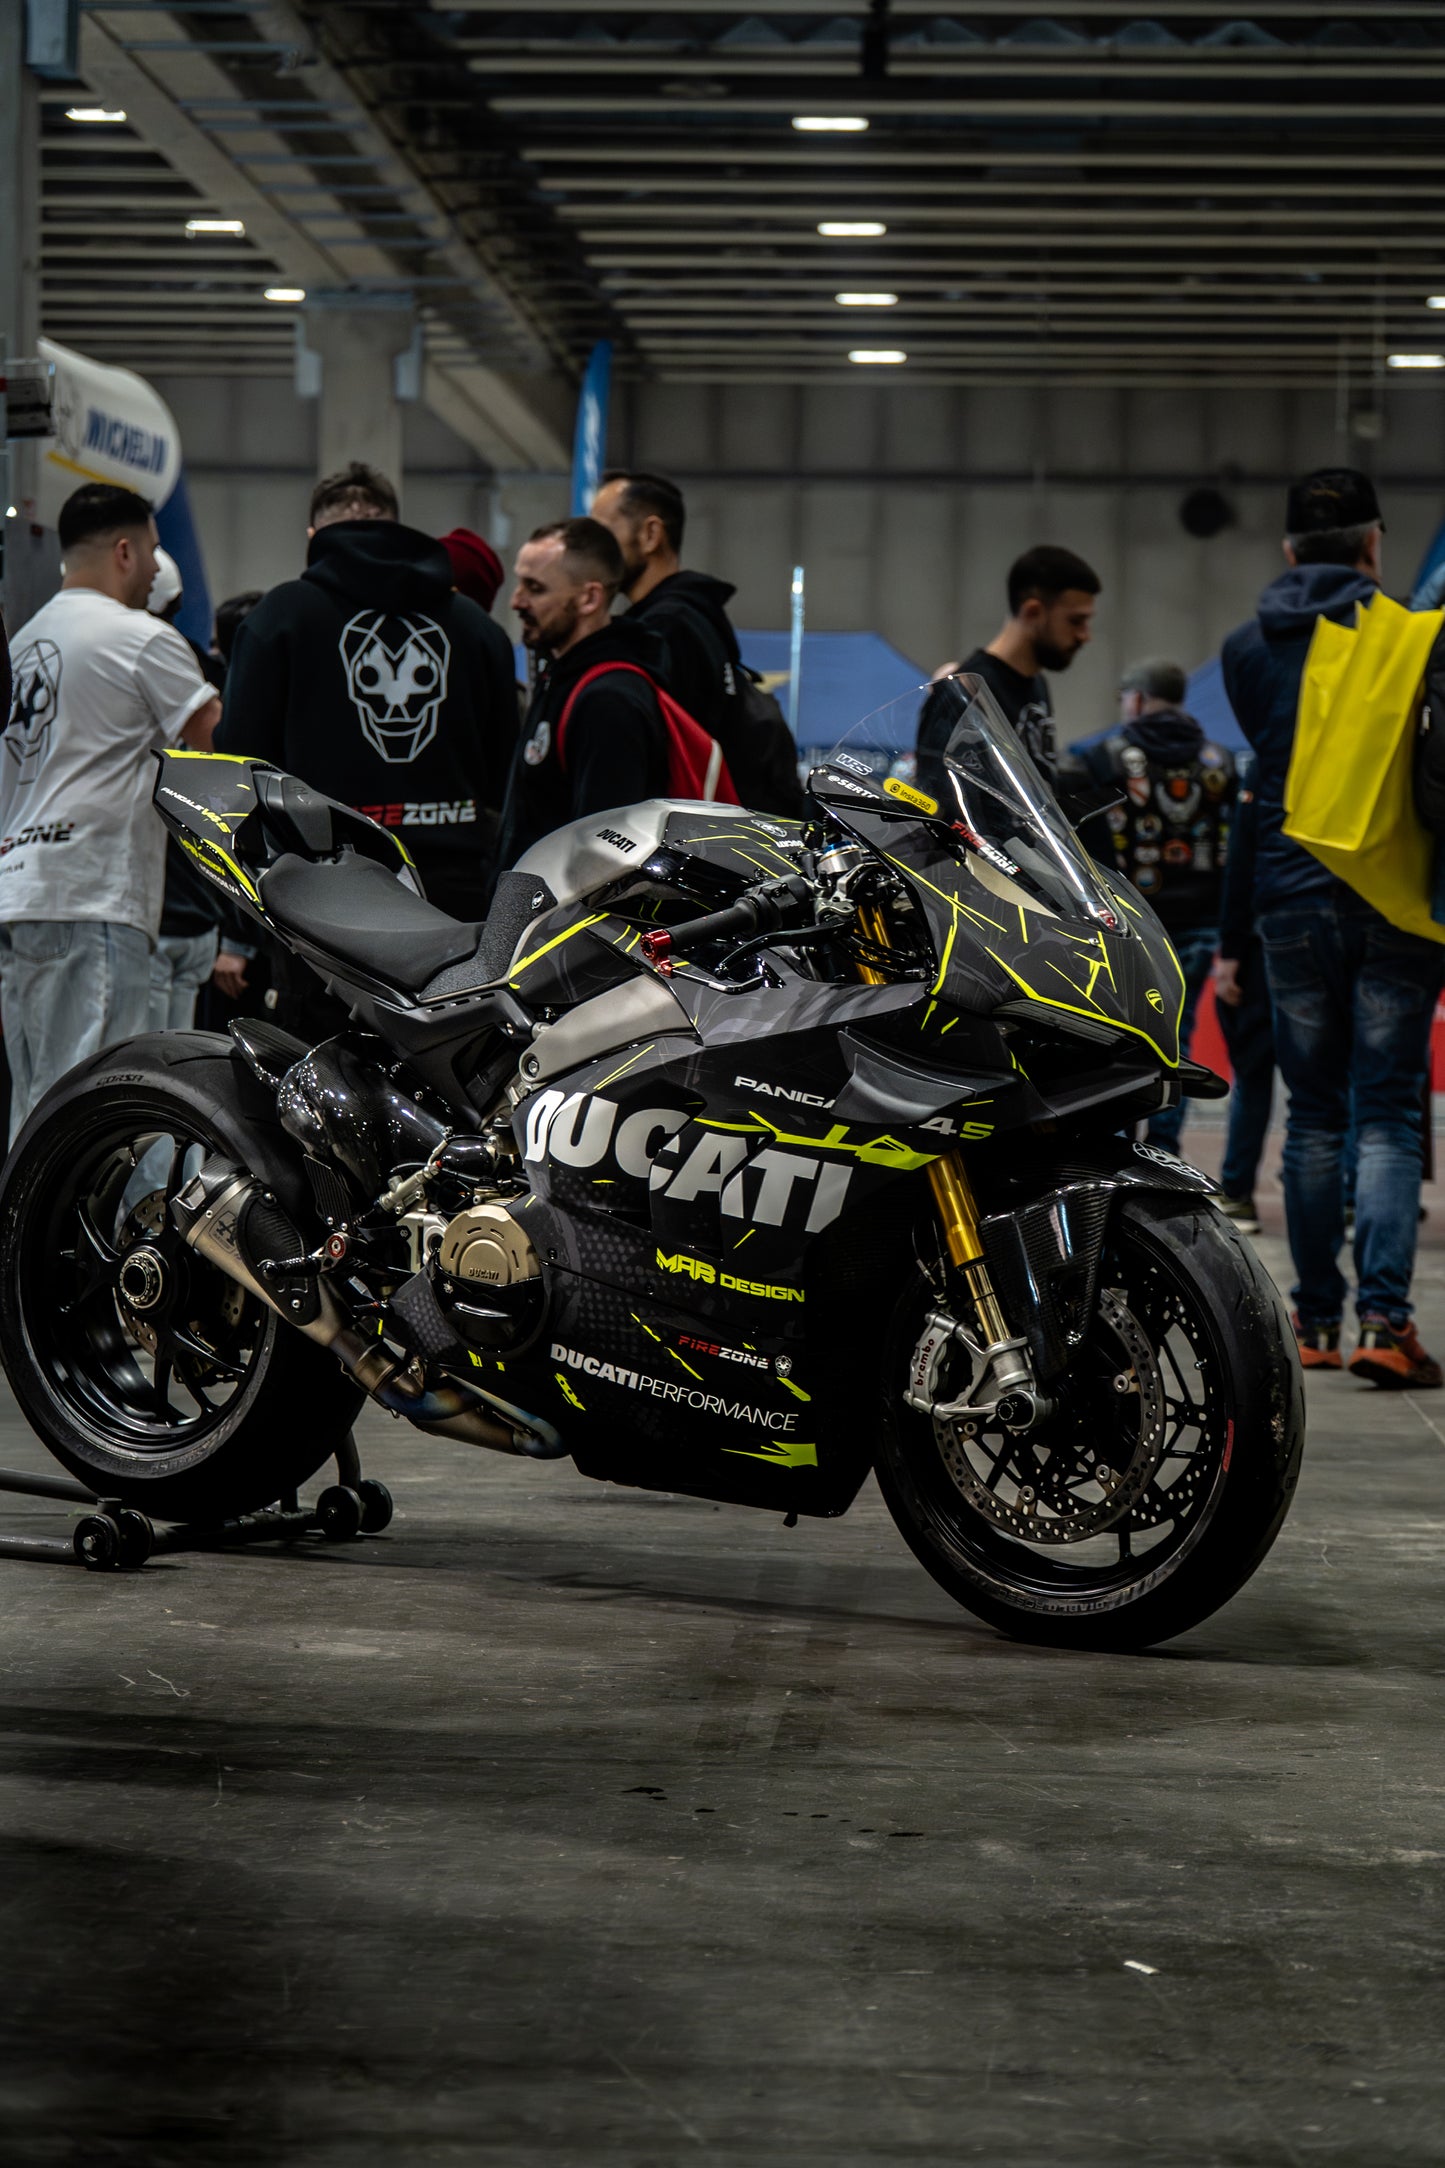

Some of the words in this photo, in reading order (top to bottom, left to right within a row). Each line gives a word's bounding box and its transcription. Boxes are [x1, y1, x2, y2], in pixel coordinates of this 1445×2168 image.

[595, 828, 637, 854] DUCATI
[524, 1089, 854, 1234] DUCATI
[468, 1267, 500, 1281] DUCATI
[720, 1272, 805, 1302] DESIGN
[678, 1335, 770, 1369] FIREZONE
[914, 1338, 935, 1386] brembo
